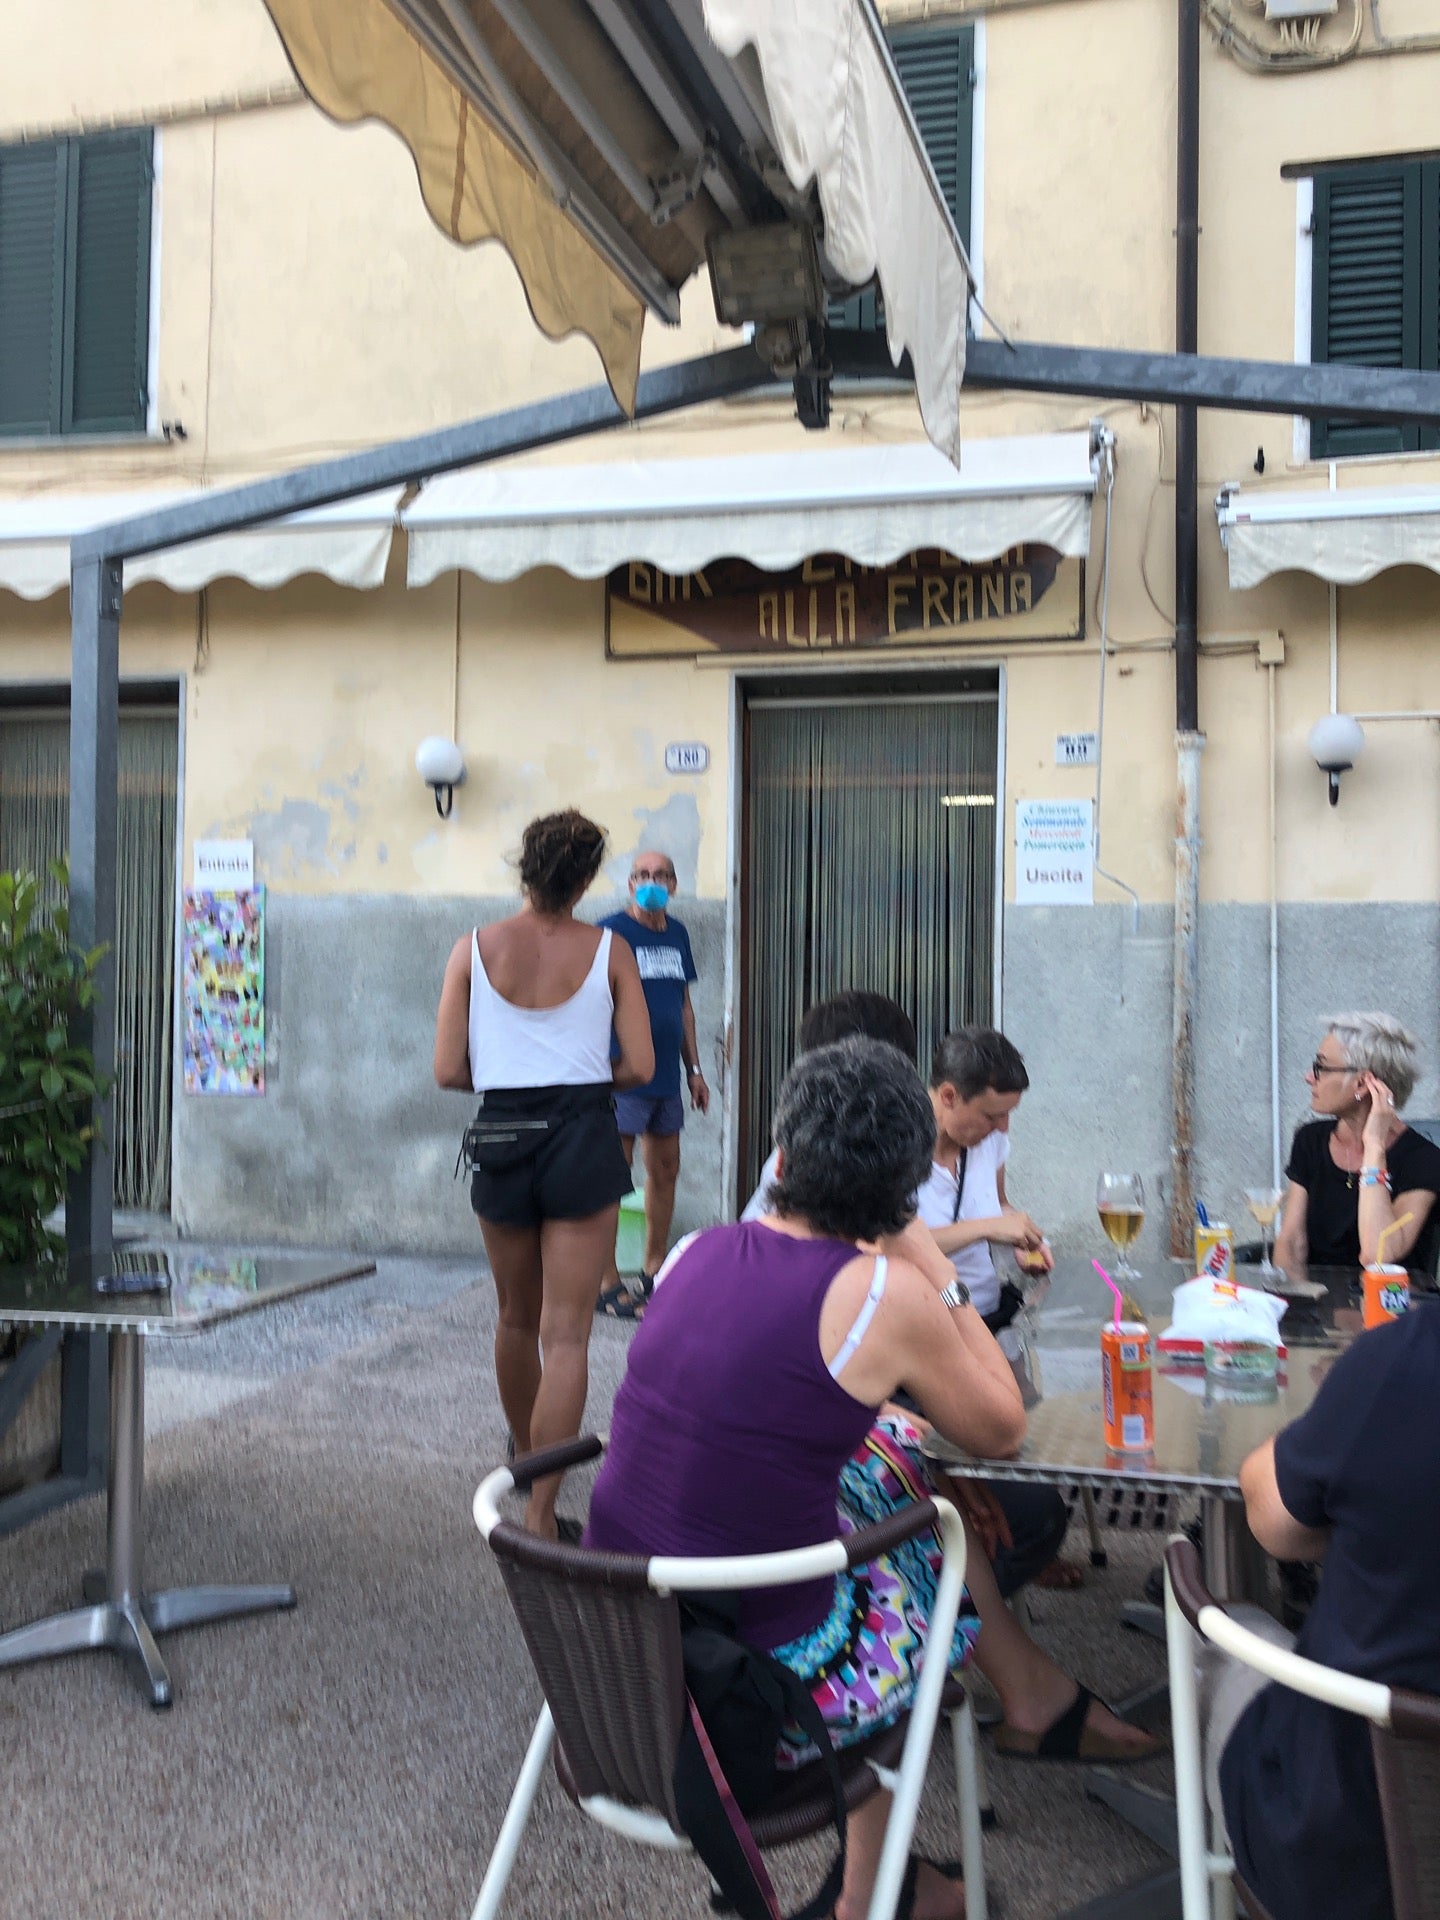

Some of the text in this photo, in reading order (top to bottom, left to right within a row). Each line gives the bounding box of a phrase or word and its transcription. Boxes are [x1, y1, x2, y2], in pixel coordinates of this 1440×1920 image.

[758, 572, 1032, 647] ALLA FRANA
[198, 855, 249, 872] Entrata
[1026, 867, 1083, 884] Uscita
